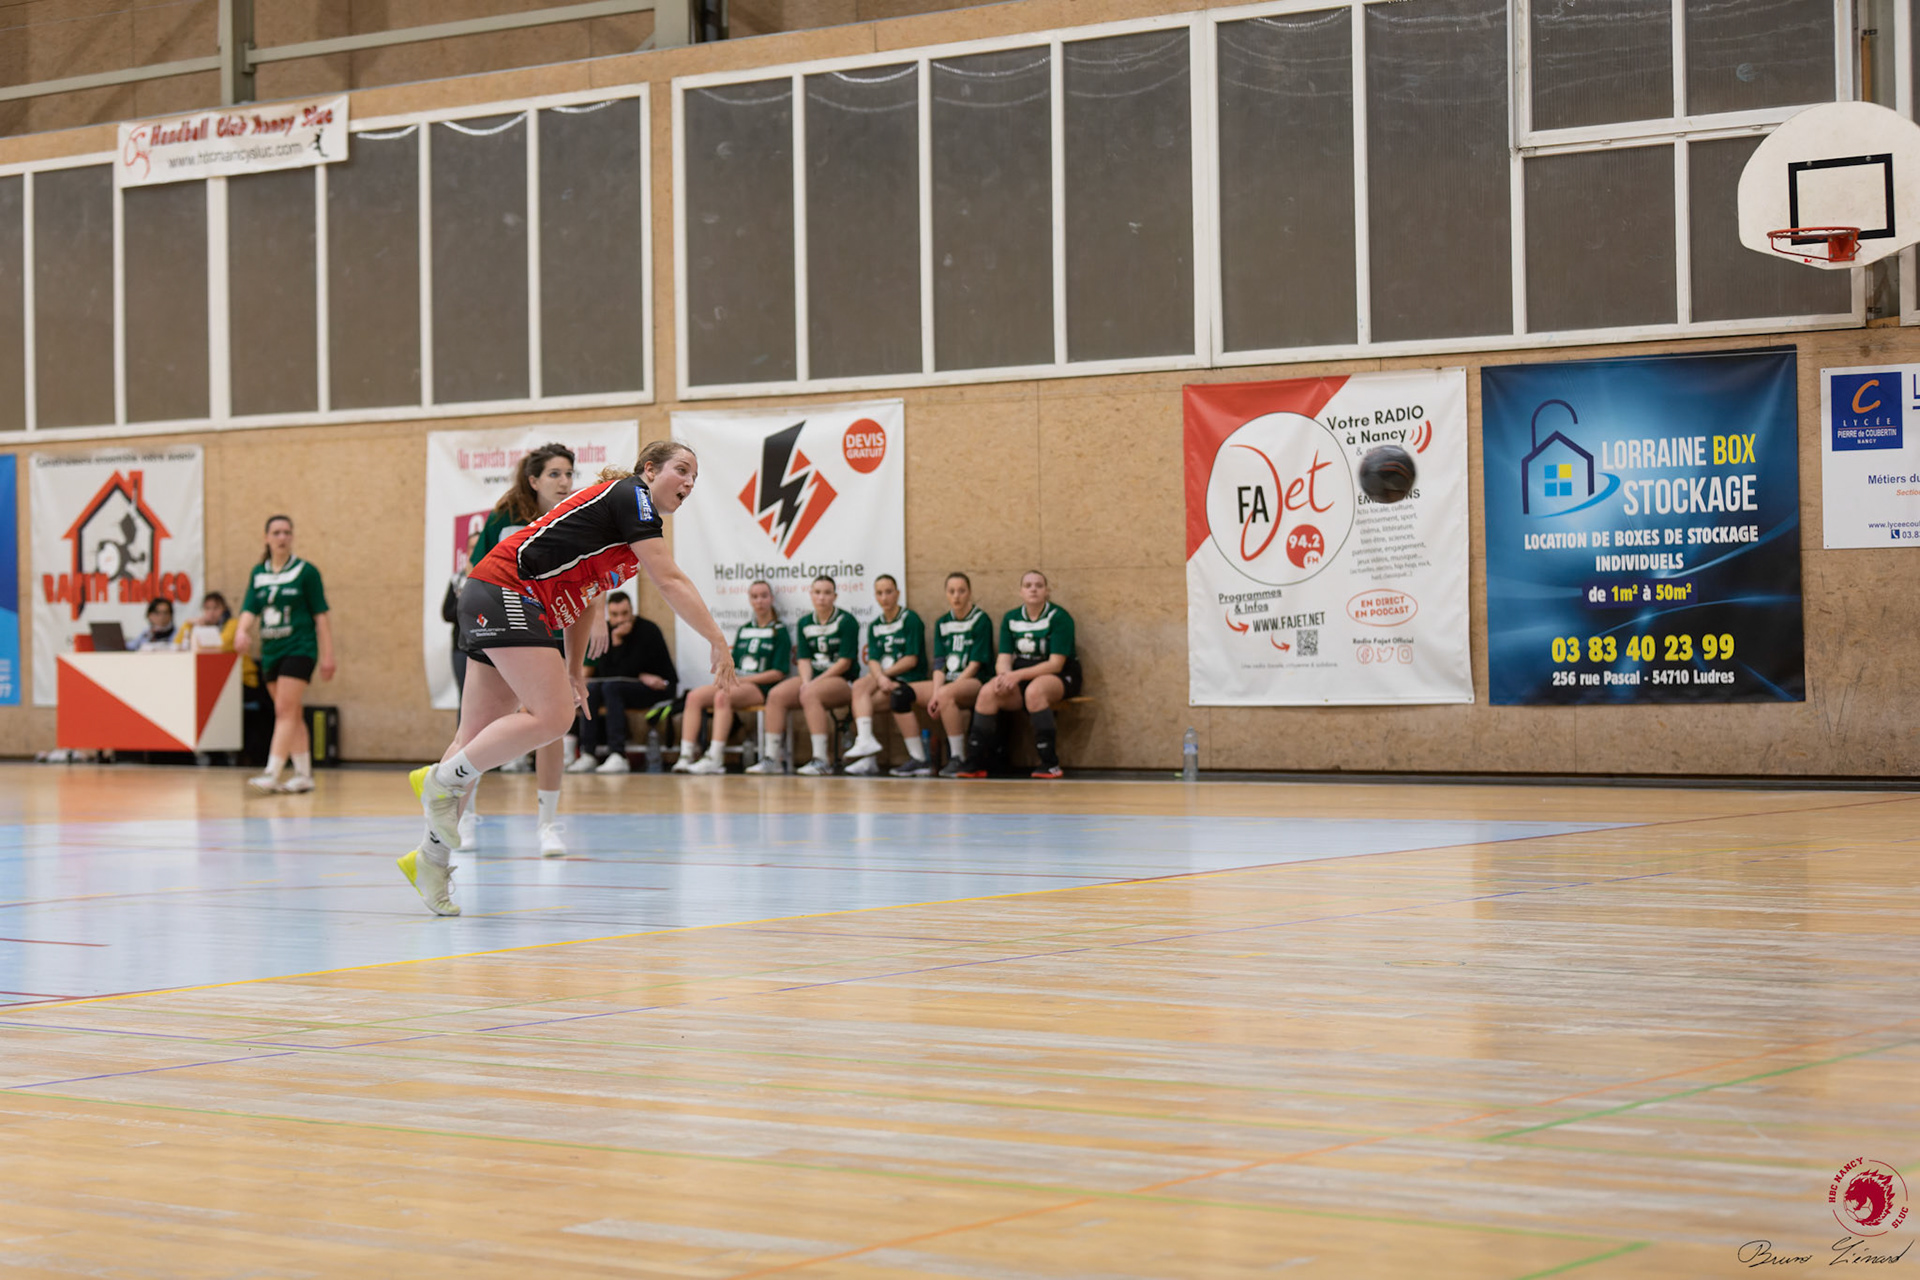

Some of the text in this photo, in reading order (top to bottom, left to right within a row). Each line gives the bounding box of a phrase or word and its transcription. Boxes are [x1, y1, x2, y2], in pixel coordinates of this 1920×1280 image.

[216, 114, 248, 138] Club
[1327, 405, 1424, 431] Votre RADIO
[1843, 416, 1891, 427] LYCÉE
[845, 432, 885, 448] DEVIS
[1346, 429, 1407, 445] à Nancy
[1837, 429, 1858, 438] PIERRE
[1865, 428, 1897, 438] COUBERTIN
[846, 447, 884, 459] GRATUIT
[1602, 433, 1757, 471] LORRAINE BOX
[1868, 474, 1907, 485] Métiers
[1623, 475, 1758, 516] STOCKAGE
[1288, 533, 1320, 549] 94.2
[1524, 525, 1759, 550] LOCATION DE BOXES DE STOCKAGE
[1306, 556, 1319, 564] FM
[1595, 552, 1684, 572] INDIVIDUELS
[714, 561, 864, 581] HelloHomeLorraine
[267, 585, 280, 604] 7
[1218, 589, 1282, 604] Programmes
[1588, 585, 1606, 603] de
[1642, 584, 1652, 601] à
[1234, 602, 1269, 614] & Infos
[1361, 596, 1405, 608] EN DIRECT
[1355, 605, 1409, 618] EN PODCAST
[1252, 611, 1326, 633] WWW.FAJET.NET
[1373, 637, 1391, 646] Fajet
[1551, 633, 1735, 663] 03 83 40 23 99
[1552, 671, 1576, 687] 256
[1579, 673, 1600, 686] rue
[1603, 669, 1641, 686] Pascal
[1652, 669, 1690, 685] 54710
[1693, 668, 1735, 685] Ludres
